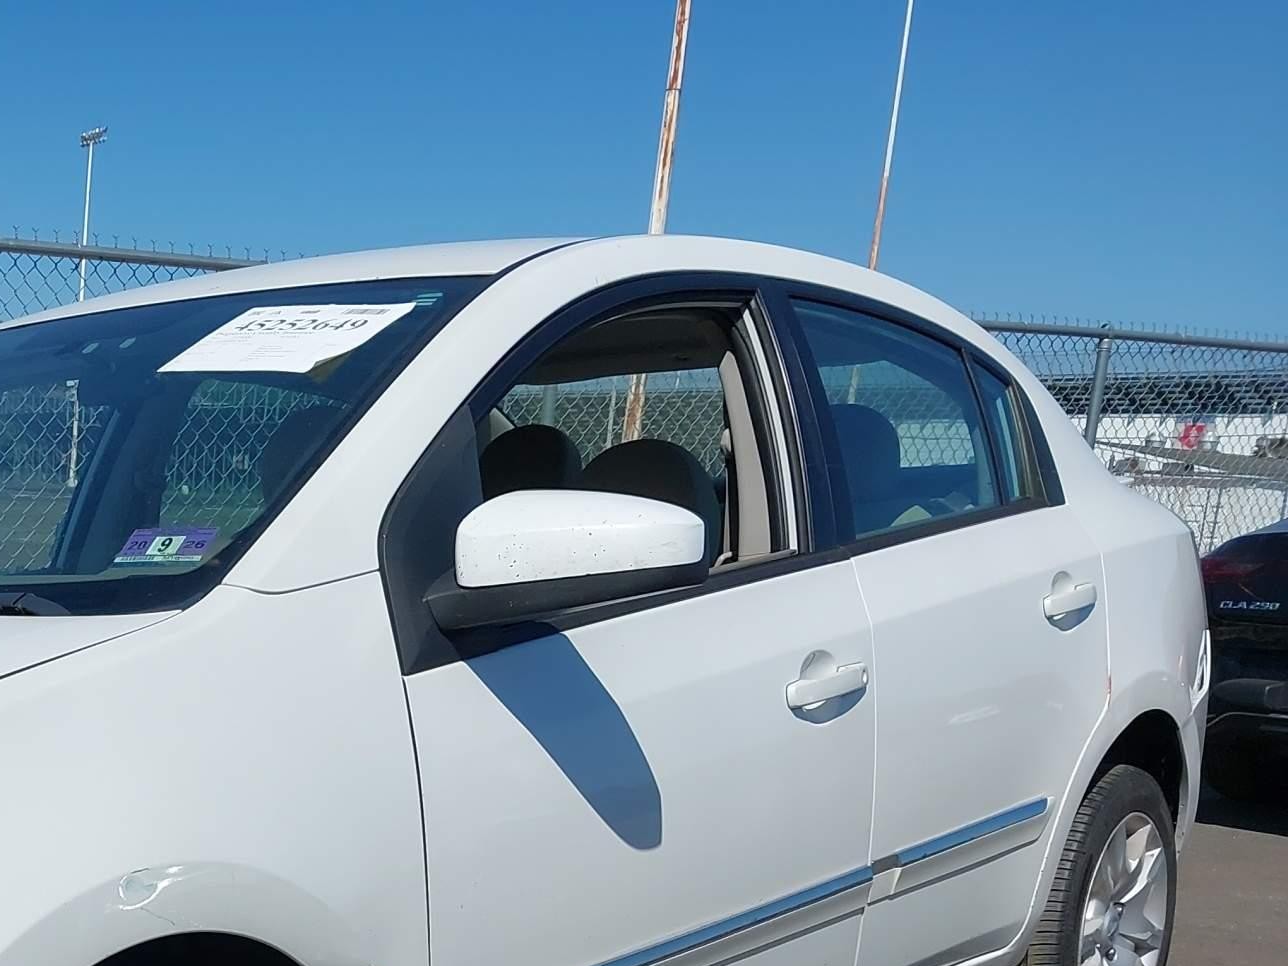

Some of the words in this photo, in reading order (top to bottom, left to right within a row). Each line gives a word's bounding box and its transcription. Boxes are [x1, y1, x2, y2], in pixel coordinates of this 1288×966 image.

[234, 317, 369, 332] 45252649
[127, 540, 148, 551] 20
[157, 537, 174, 553] 9
[183, 540, 207, 550] 26
[1219, 600, 1247, 609] CLA
